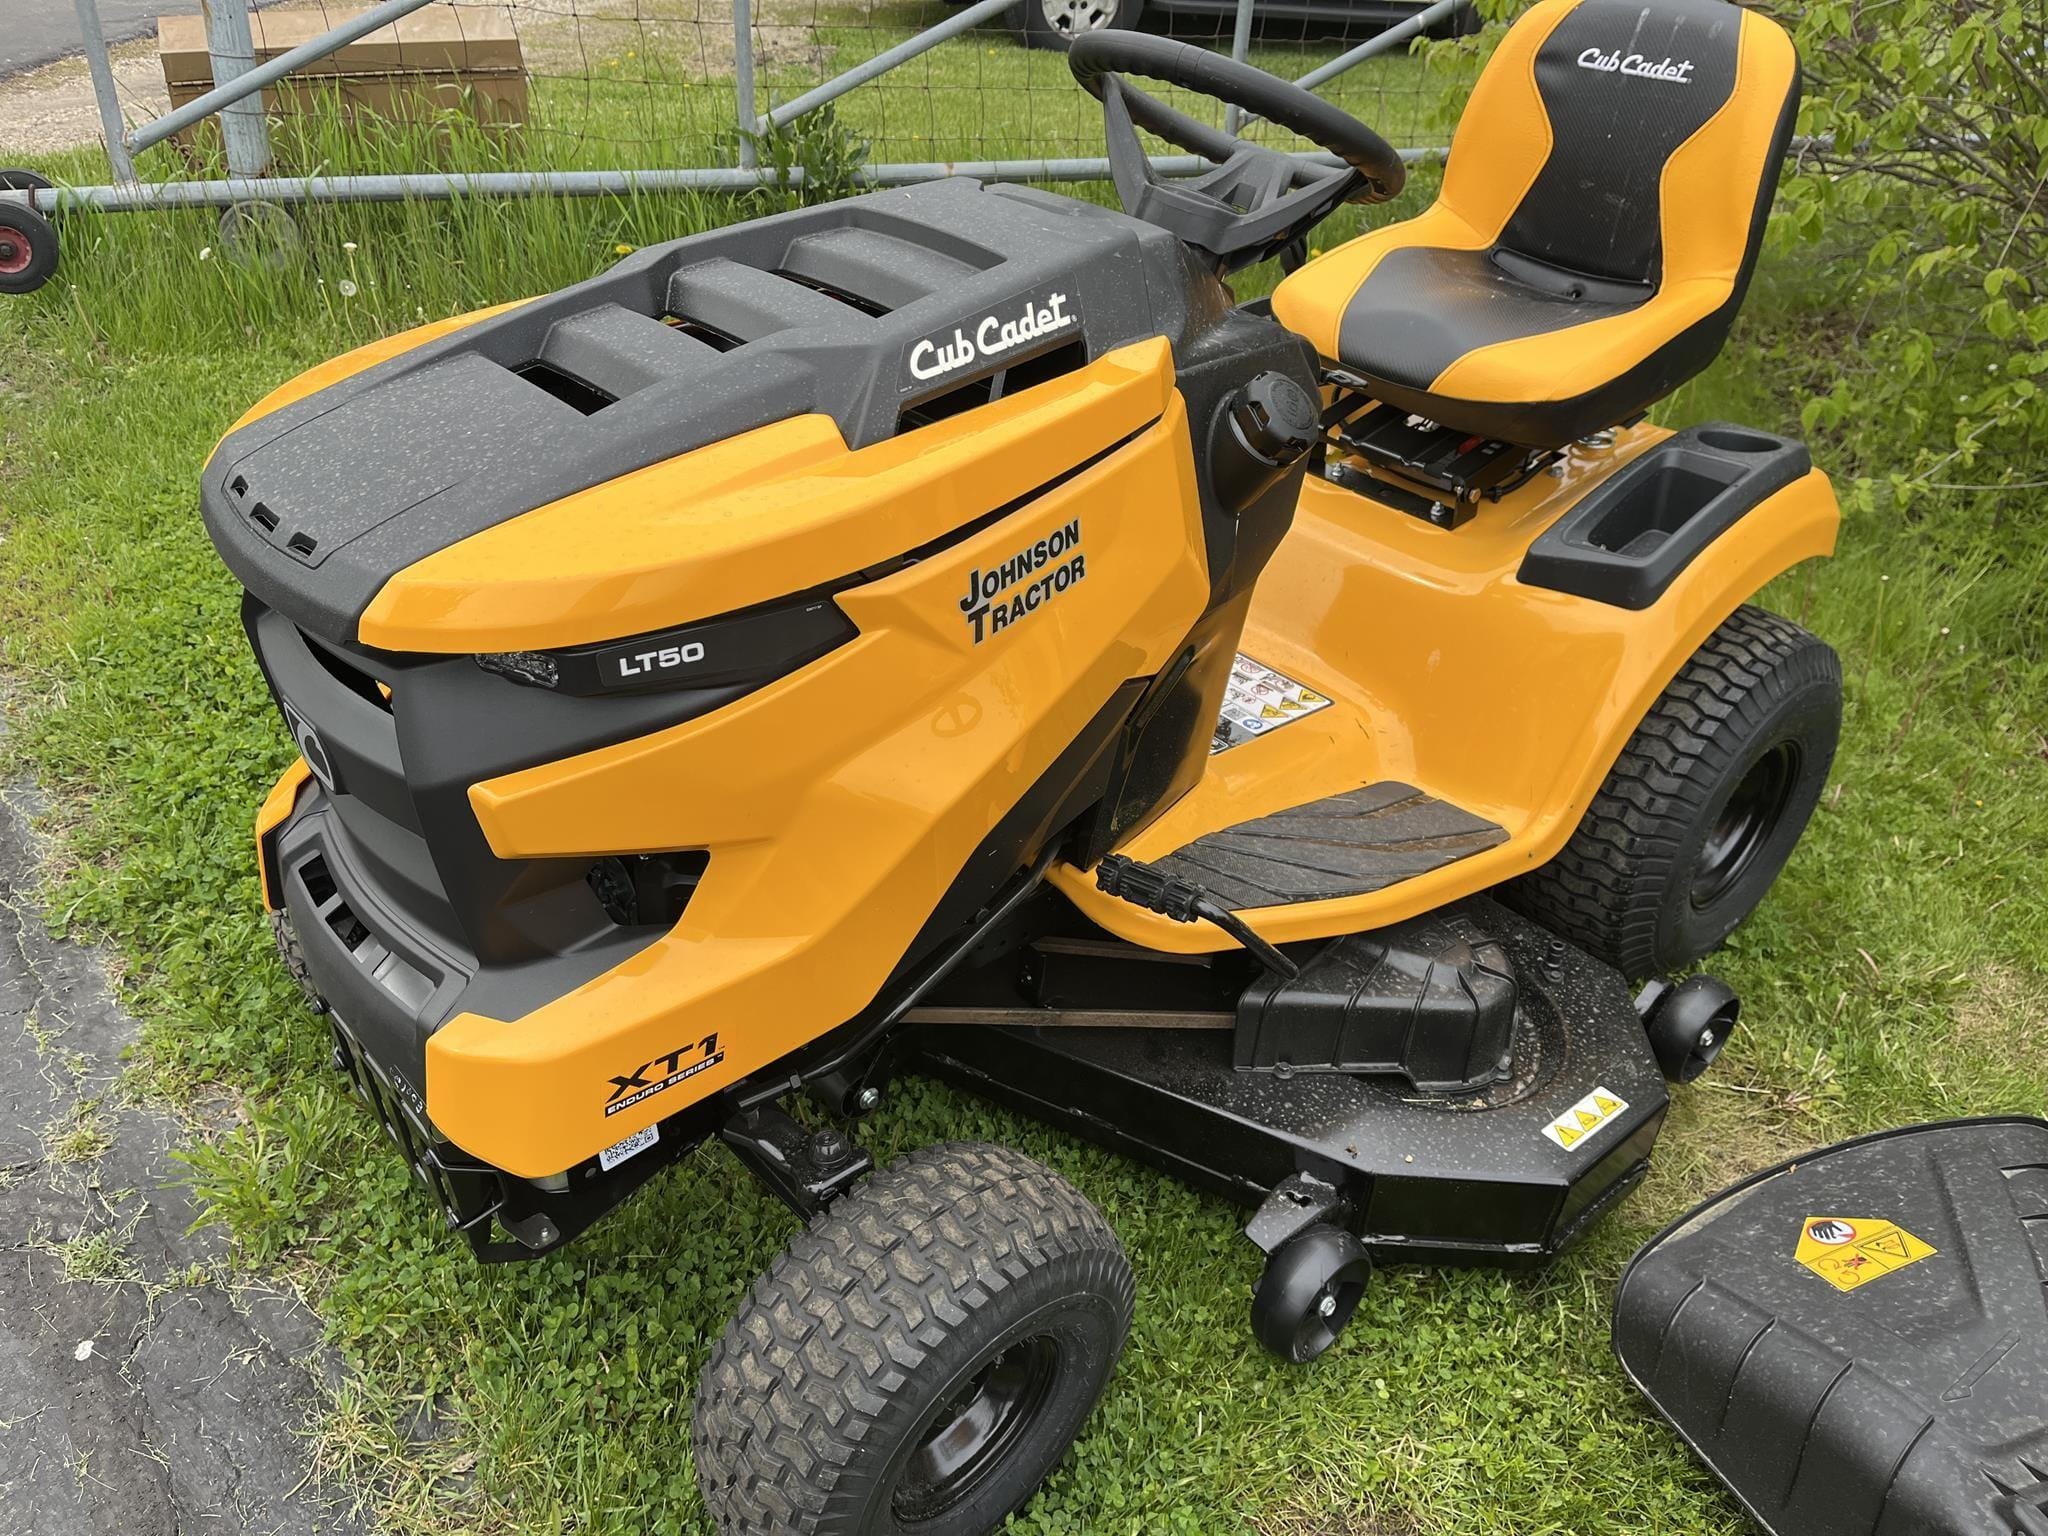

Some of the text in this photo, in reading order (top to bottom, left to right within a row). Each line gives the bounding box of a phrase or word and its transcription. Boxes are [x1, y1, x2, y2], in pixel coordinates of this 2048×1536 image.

[1577, 47, 1695, 84] Cub Cadet
[910, 292, 1072, 380] Cub Cadet
[959, 518, 1080, 612] JOHNSON
[967, 554, 1086, 645] TRACTOR
[619, 642, 705, 677] LT50
[605, 1032, 718, 1104] XT1
[607, 1057, 715, 1115] ENDURO SERIES
